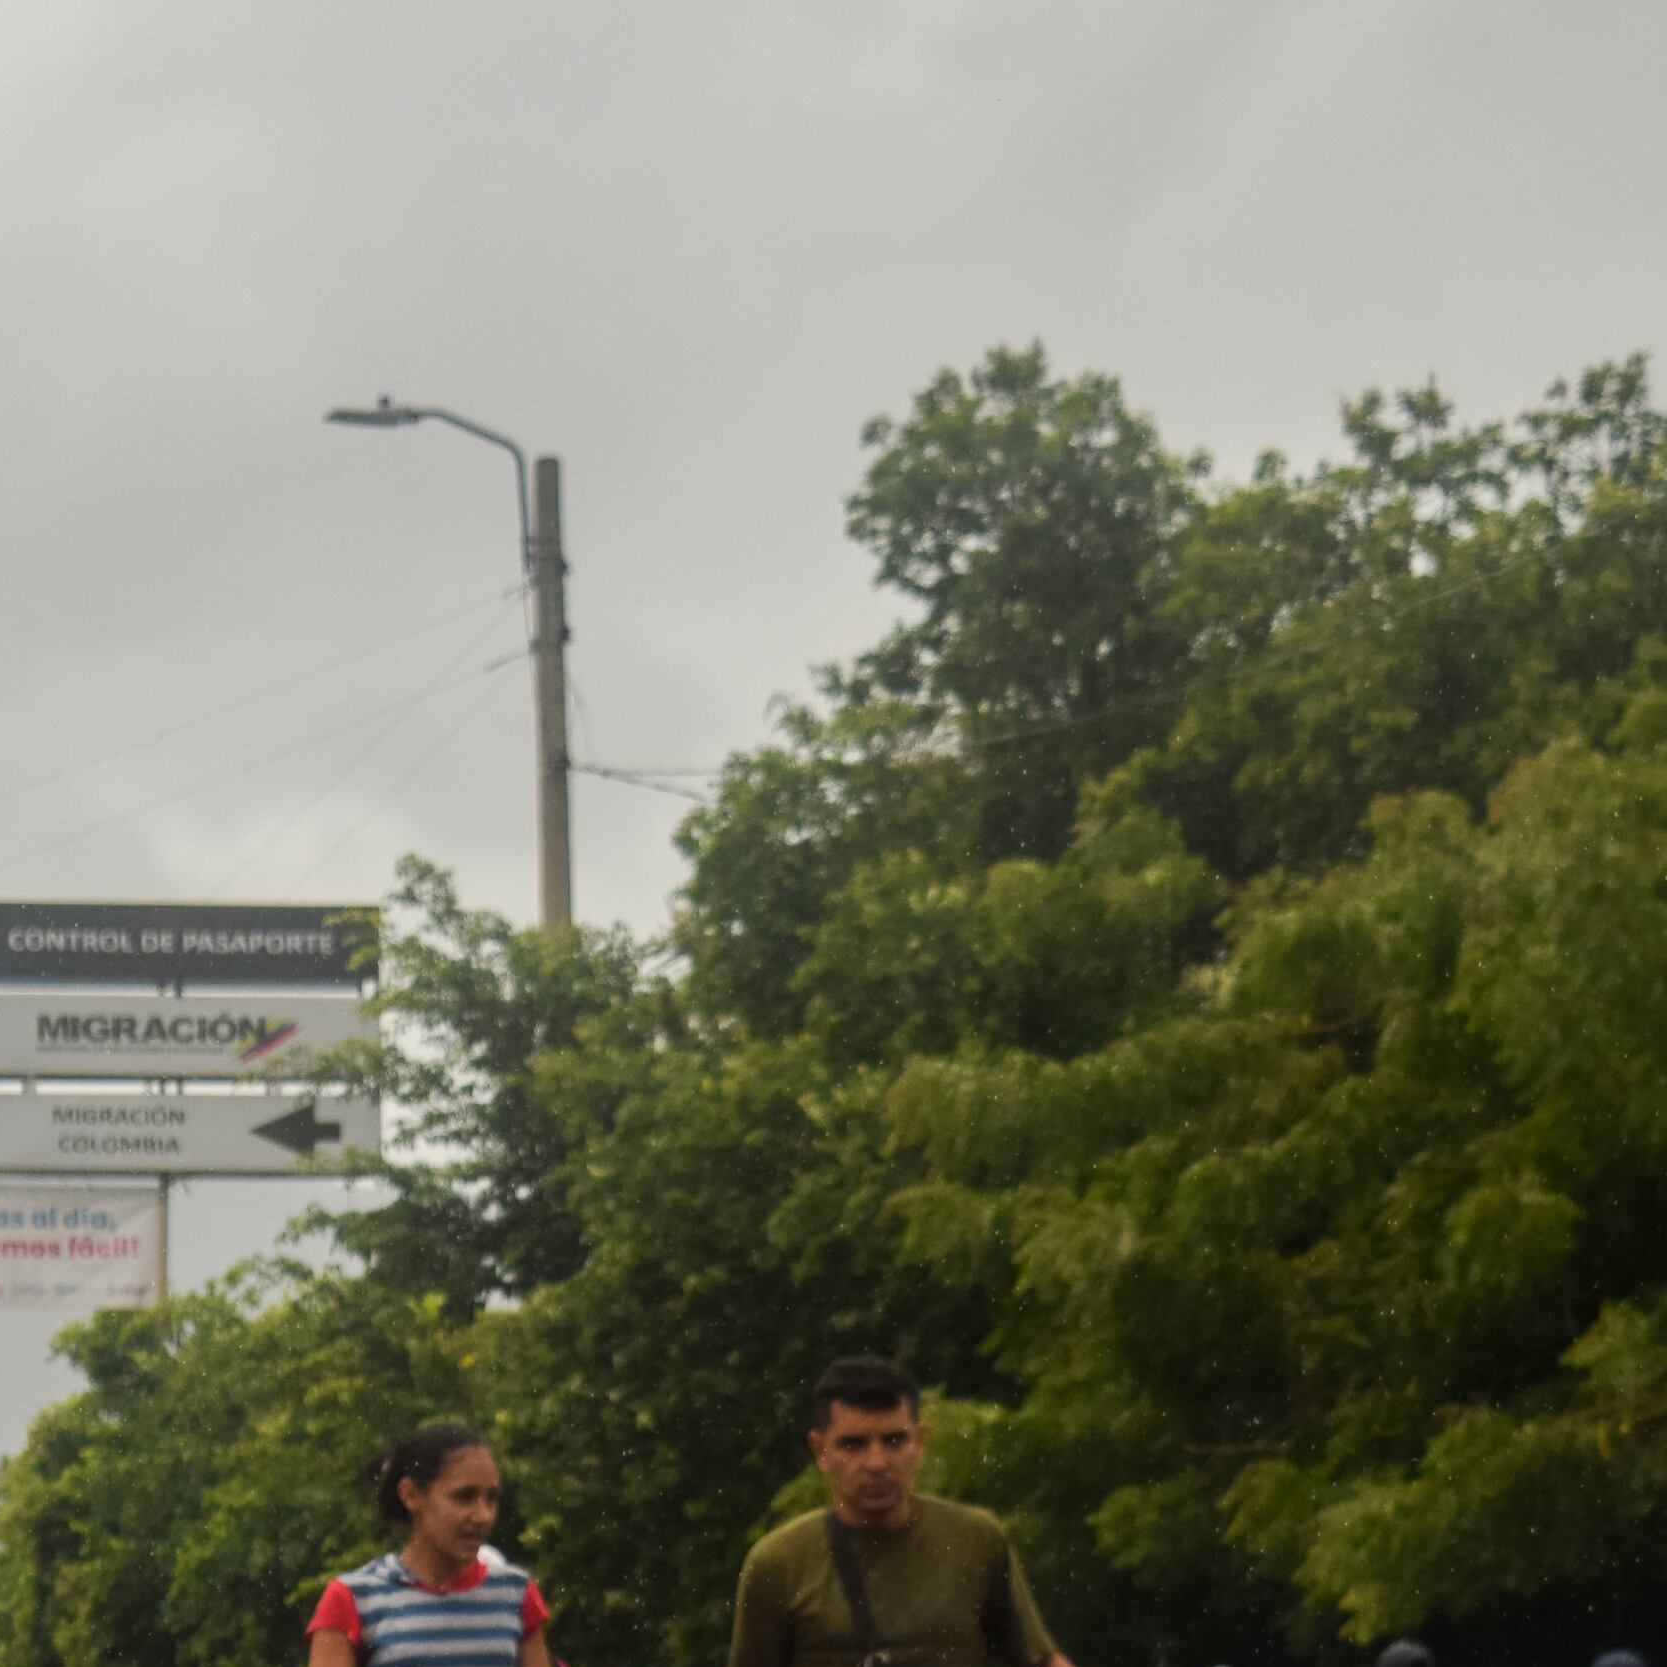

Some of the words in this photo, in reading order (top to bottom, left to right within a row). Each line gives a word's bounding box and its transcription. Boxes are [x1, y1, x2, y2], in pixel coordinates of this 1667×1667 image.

[8, 927, 134, 952] CONTROL
[140, 929, 174, 953] DE
[182, 929, 332, 955] PASAPORTE
[36, 1012, 267, 1045] MIGRACIÓN
[52, 1103, 186, 1127] MIGRACIÓN
[58, 1134, 181, 1154] COLOMBIA
[31, 1209, 57, 1230] al
[69, 1234, 139, 1260] fácil!
